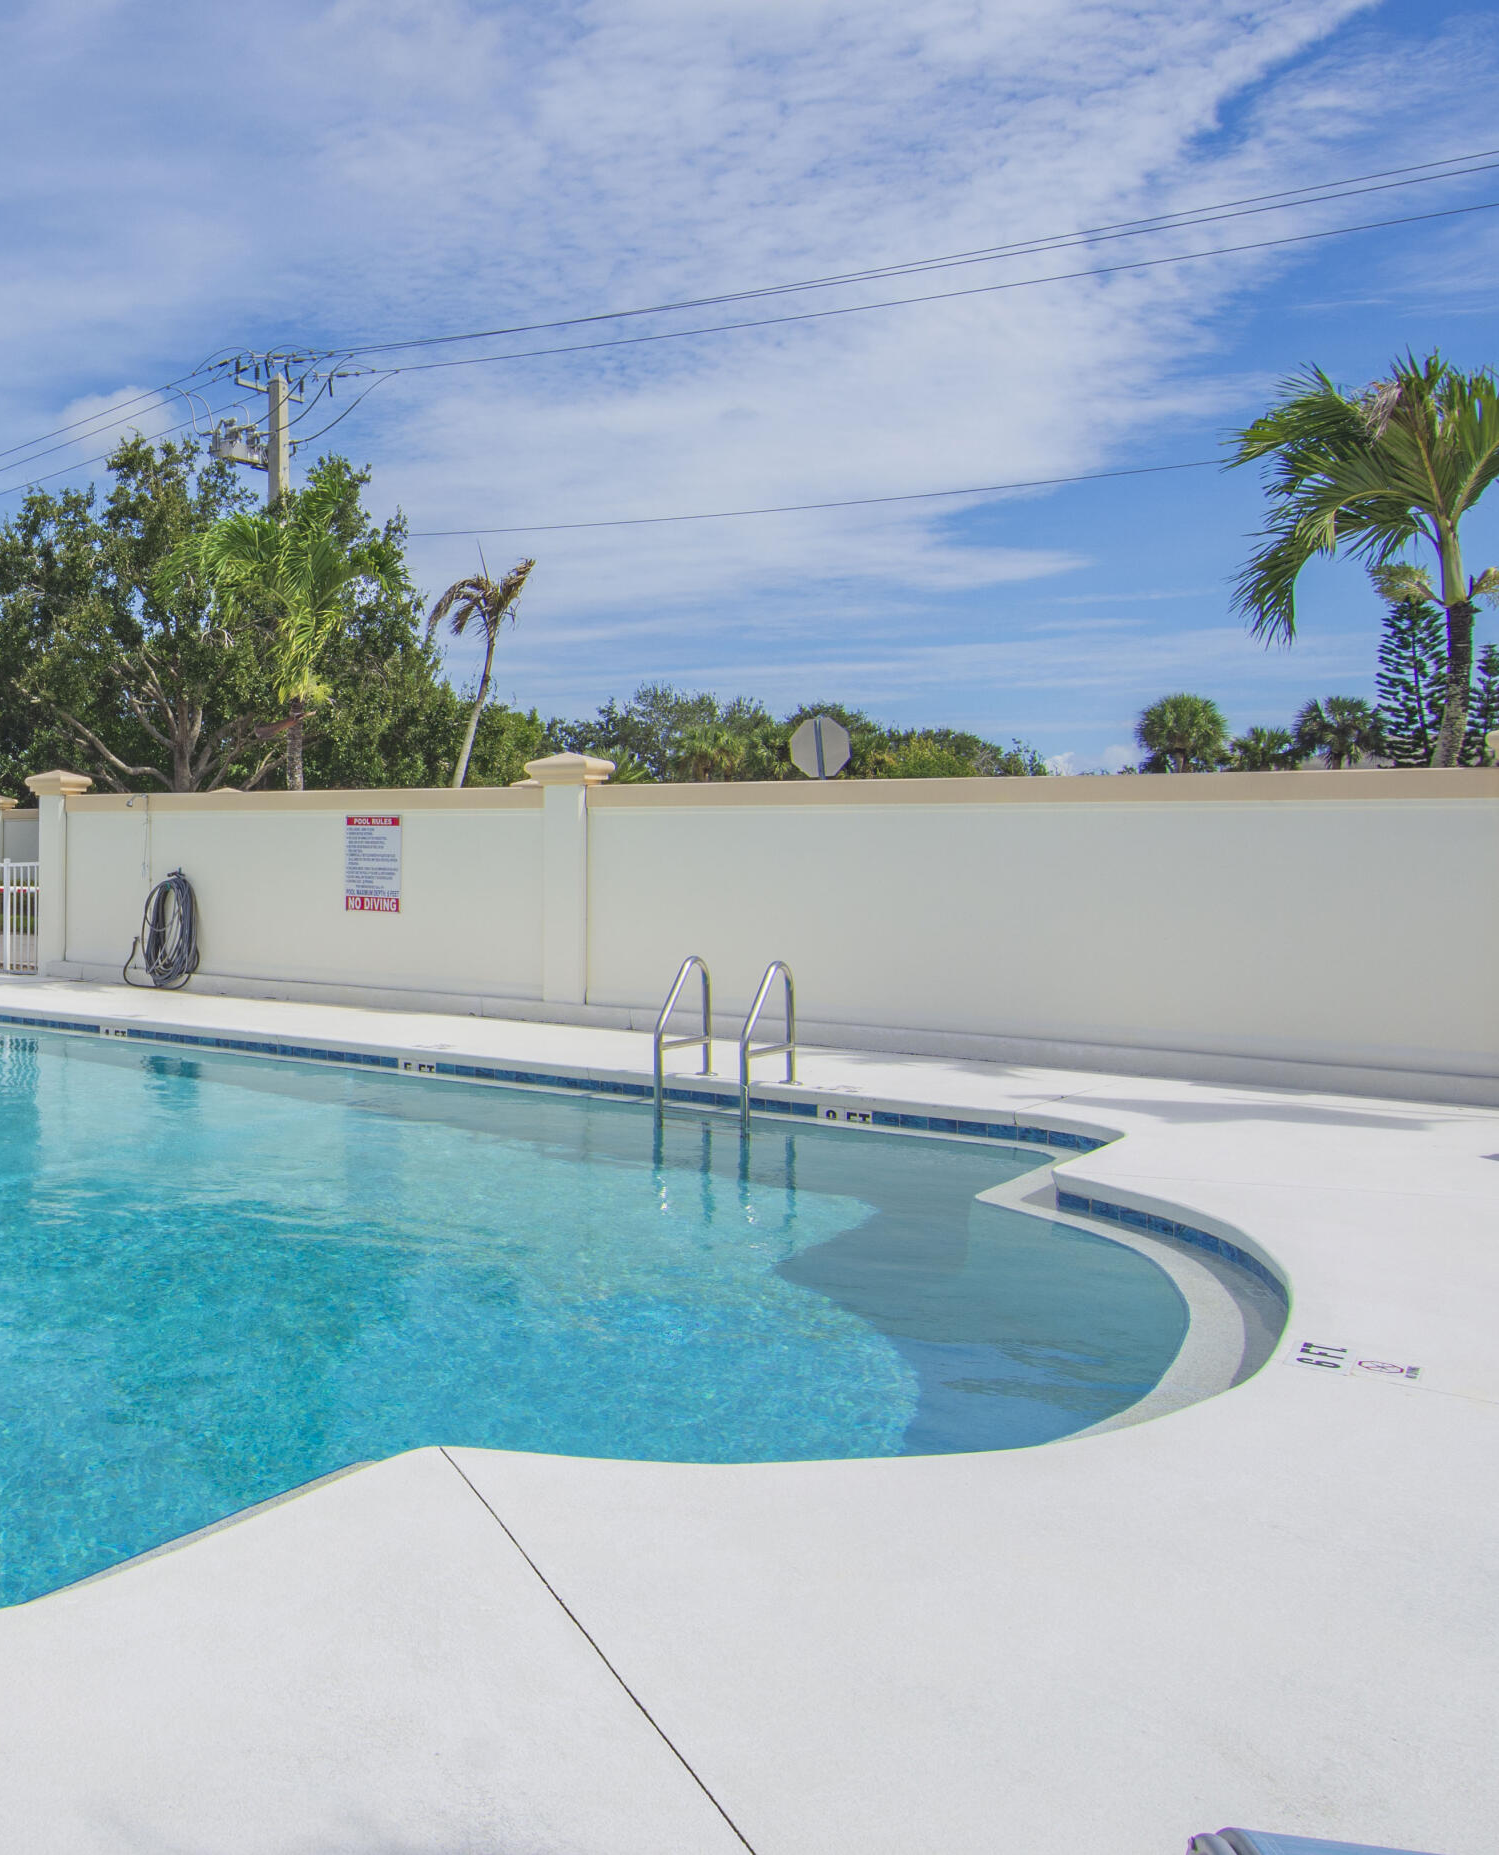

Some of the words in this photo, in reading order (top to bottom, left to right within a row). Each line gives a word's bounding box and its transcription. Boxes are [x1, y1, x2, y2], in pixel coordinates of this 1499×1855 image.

[348, 896, 362, 910] NO
[363, 897, 397, 911] DIVING
[1296, 1357, 1341, 1369] 6
